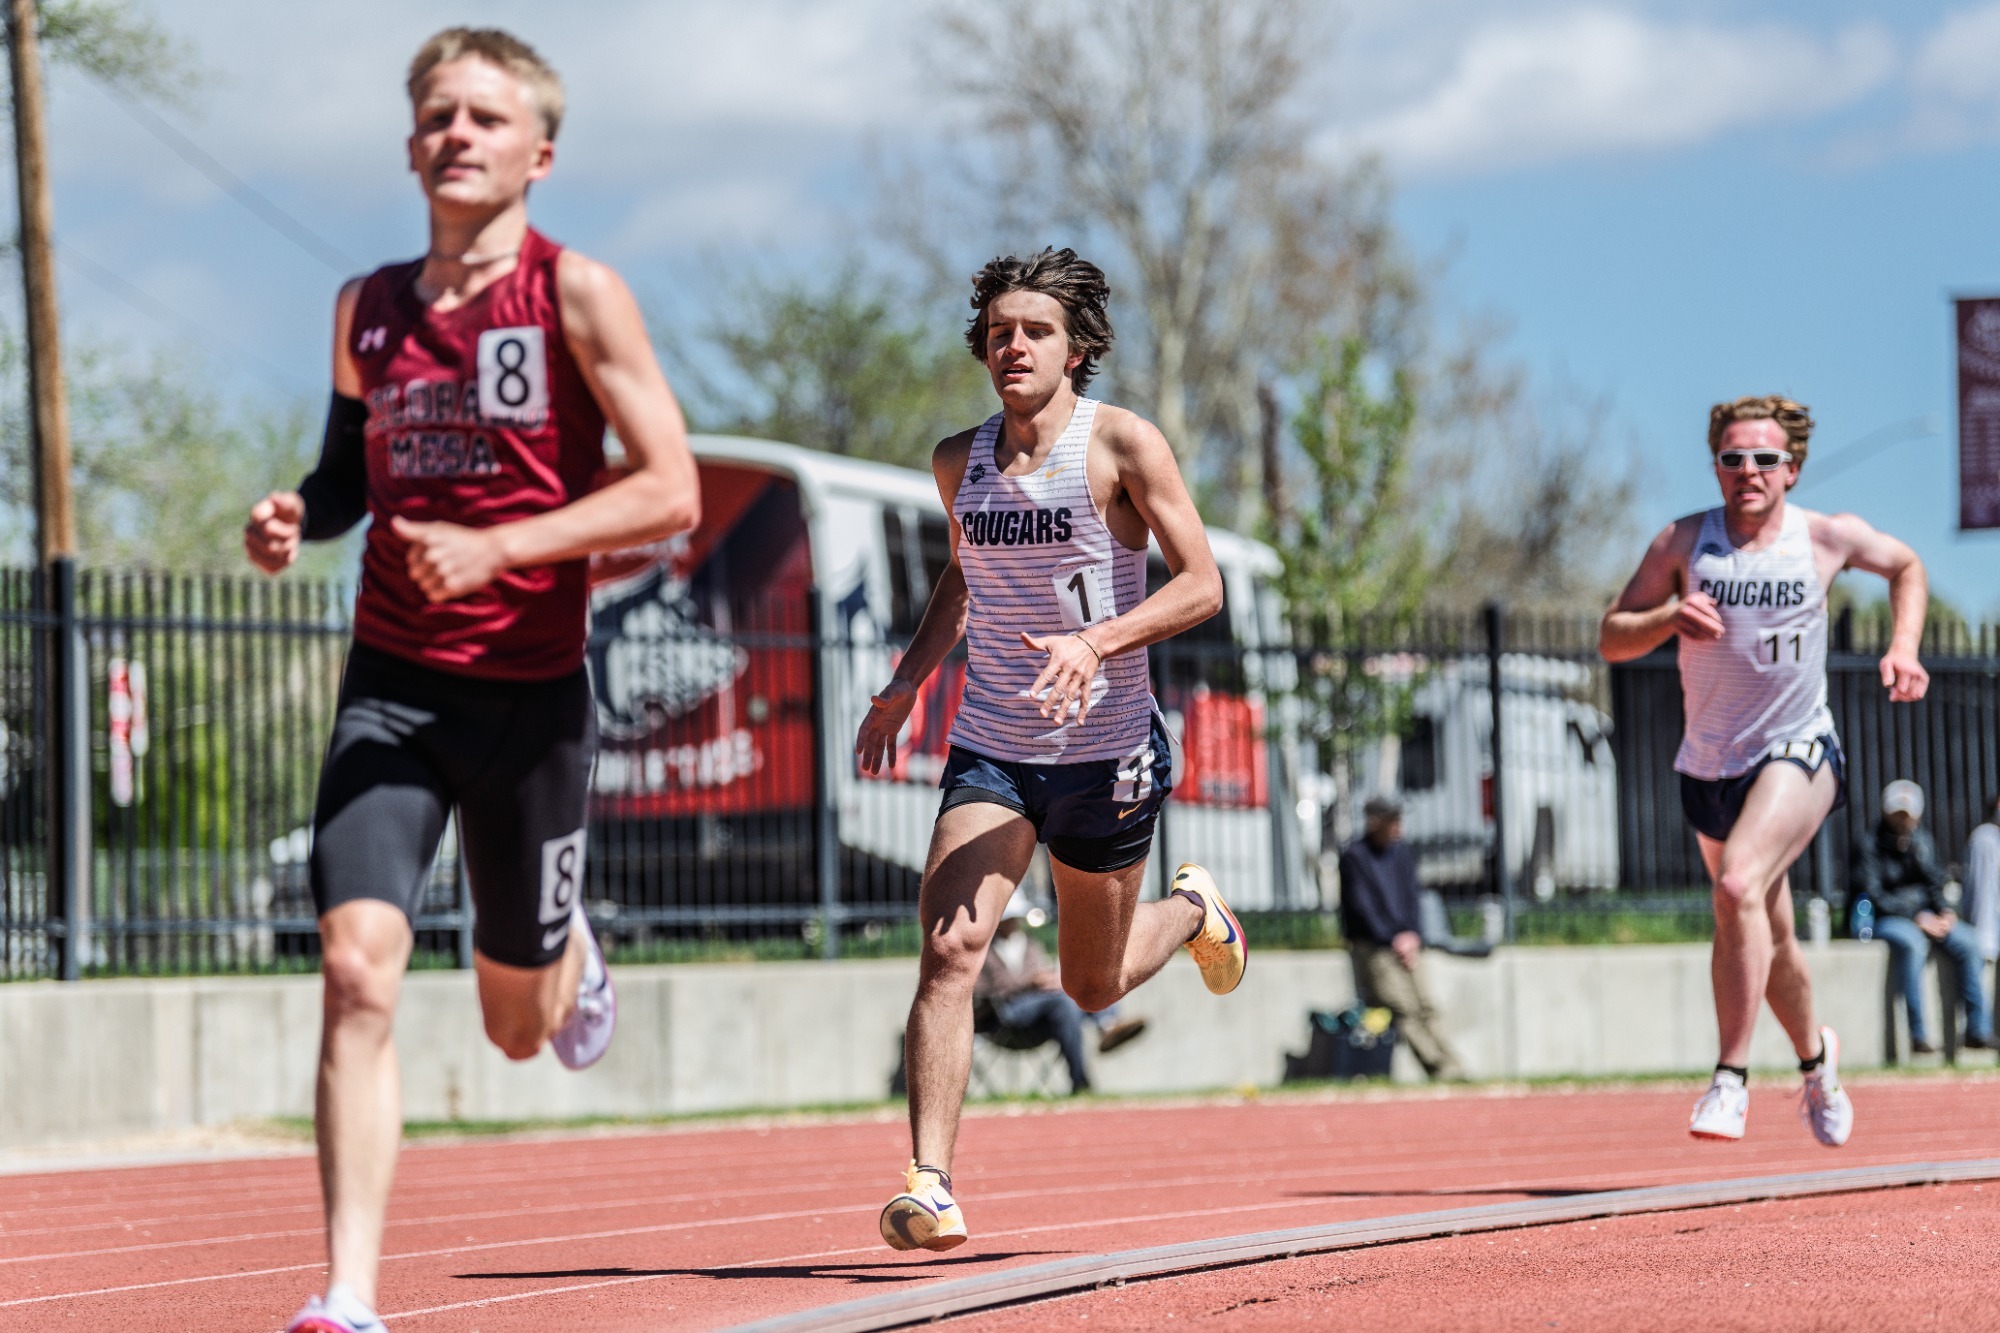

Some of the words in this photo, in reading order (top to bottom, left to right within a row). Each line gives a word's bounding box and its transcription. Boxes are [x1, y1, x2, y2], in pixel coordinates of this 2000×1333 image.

[496, 338, 530, 407] 8
[389, 433, 500, 476] MESA
[962, 507, 1073, 546] COUGARS
[1066, 572, 1093, 623] 1
[1765, 634, 1801, 663] 11
[554, 845, 576, 909] 8
